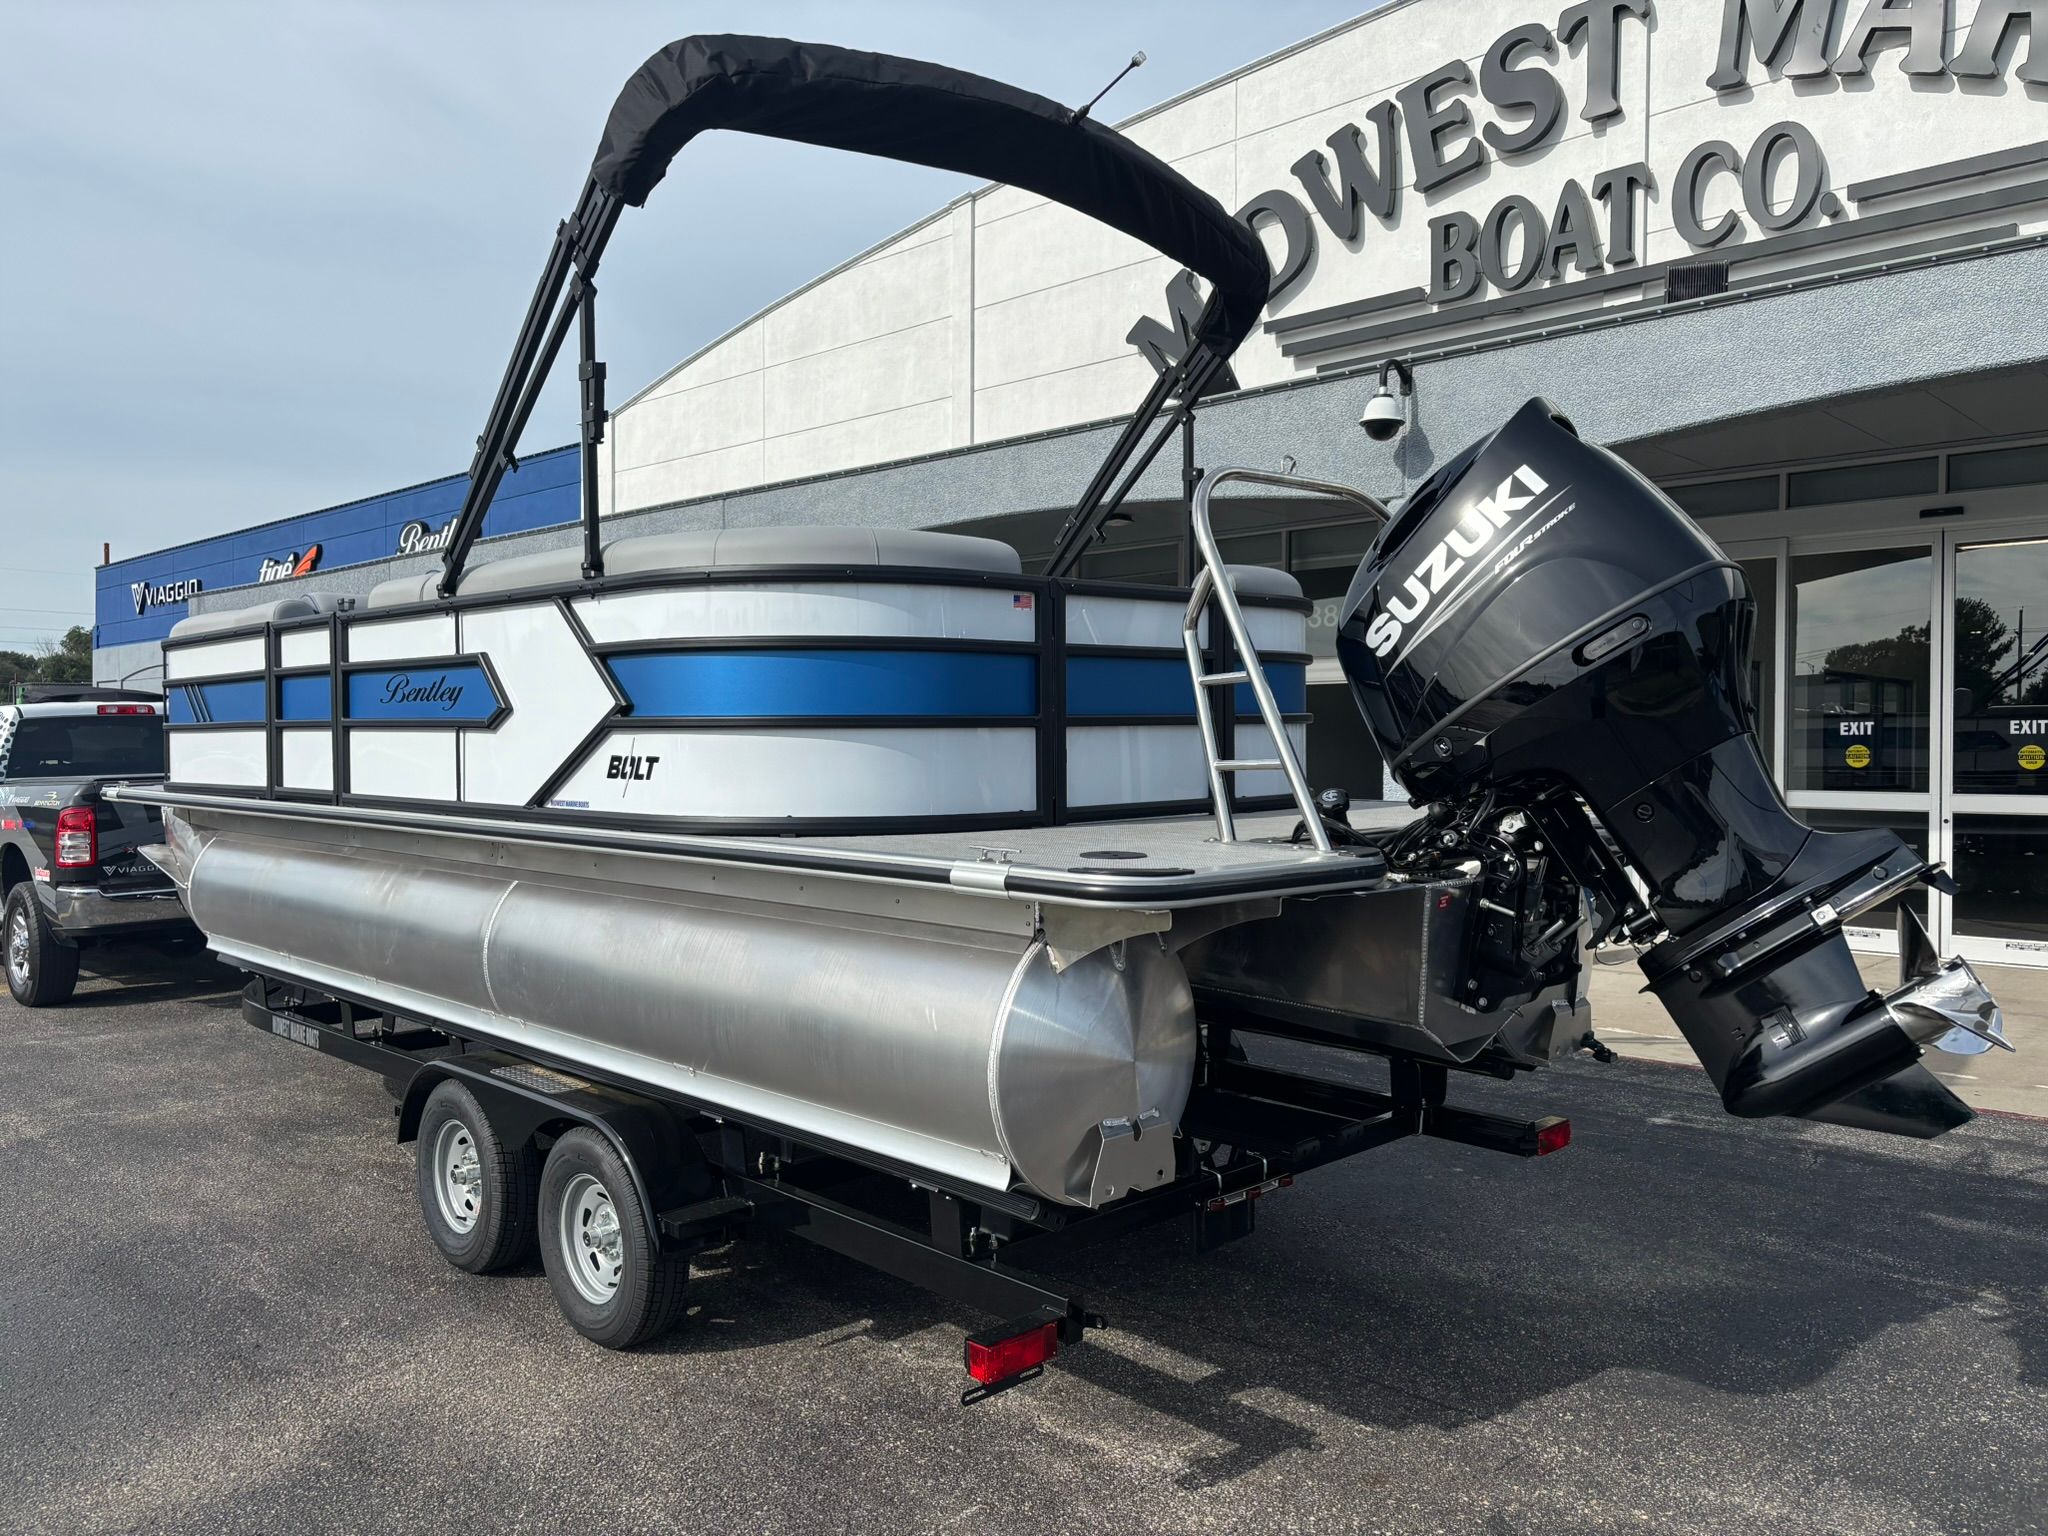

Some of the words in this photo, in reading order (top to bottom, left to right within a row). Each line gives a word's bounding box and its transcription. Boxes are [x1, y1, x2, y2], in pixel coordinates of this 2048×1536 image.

[1126, 0, 1653, 398] MDWEST
[1427, 161, 1653, 304] BOAT
[1672, 120, 1842, 248] CO.
[396, 518, 458, 556] Bentl
[1365, 463, 1550, 658] SUZUKI
[144, 578, 198, 606] VIAGGIO
[379, 673, 464, 712] Bentley
[1839, 721, 1875, 736] EXIT
[2009, 719, 2048, 735] EXIT
[606, 754, 661, 781] BOLT
[117, 864, 161, 874] VIAGG
